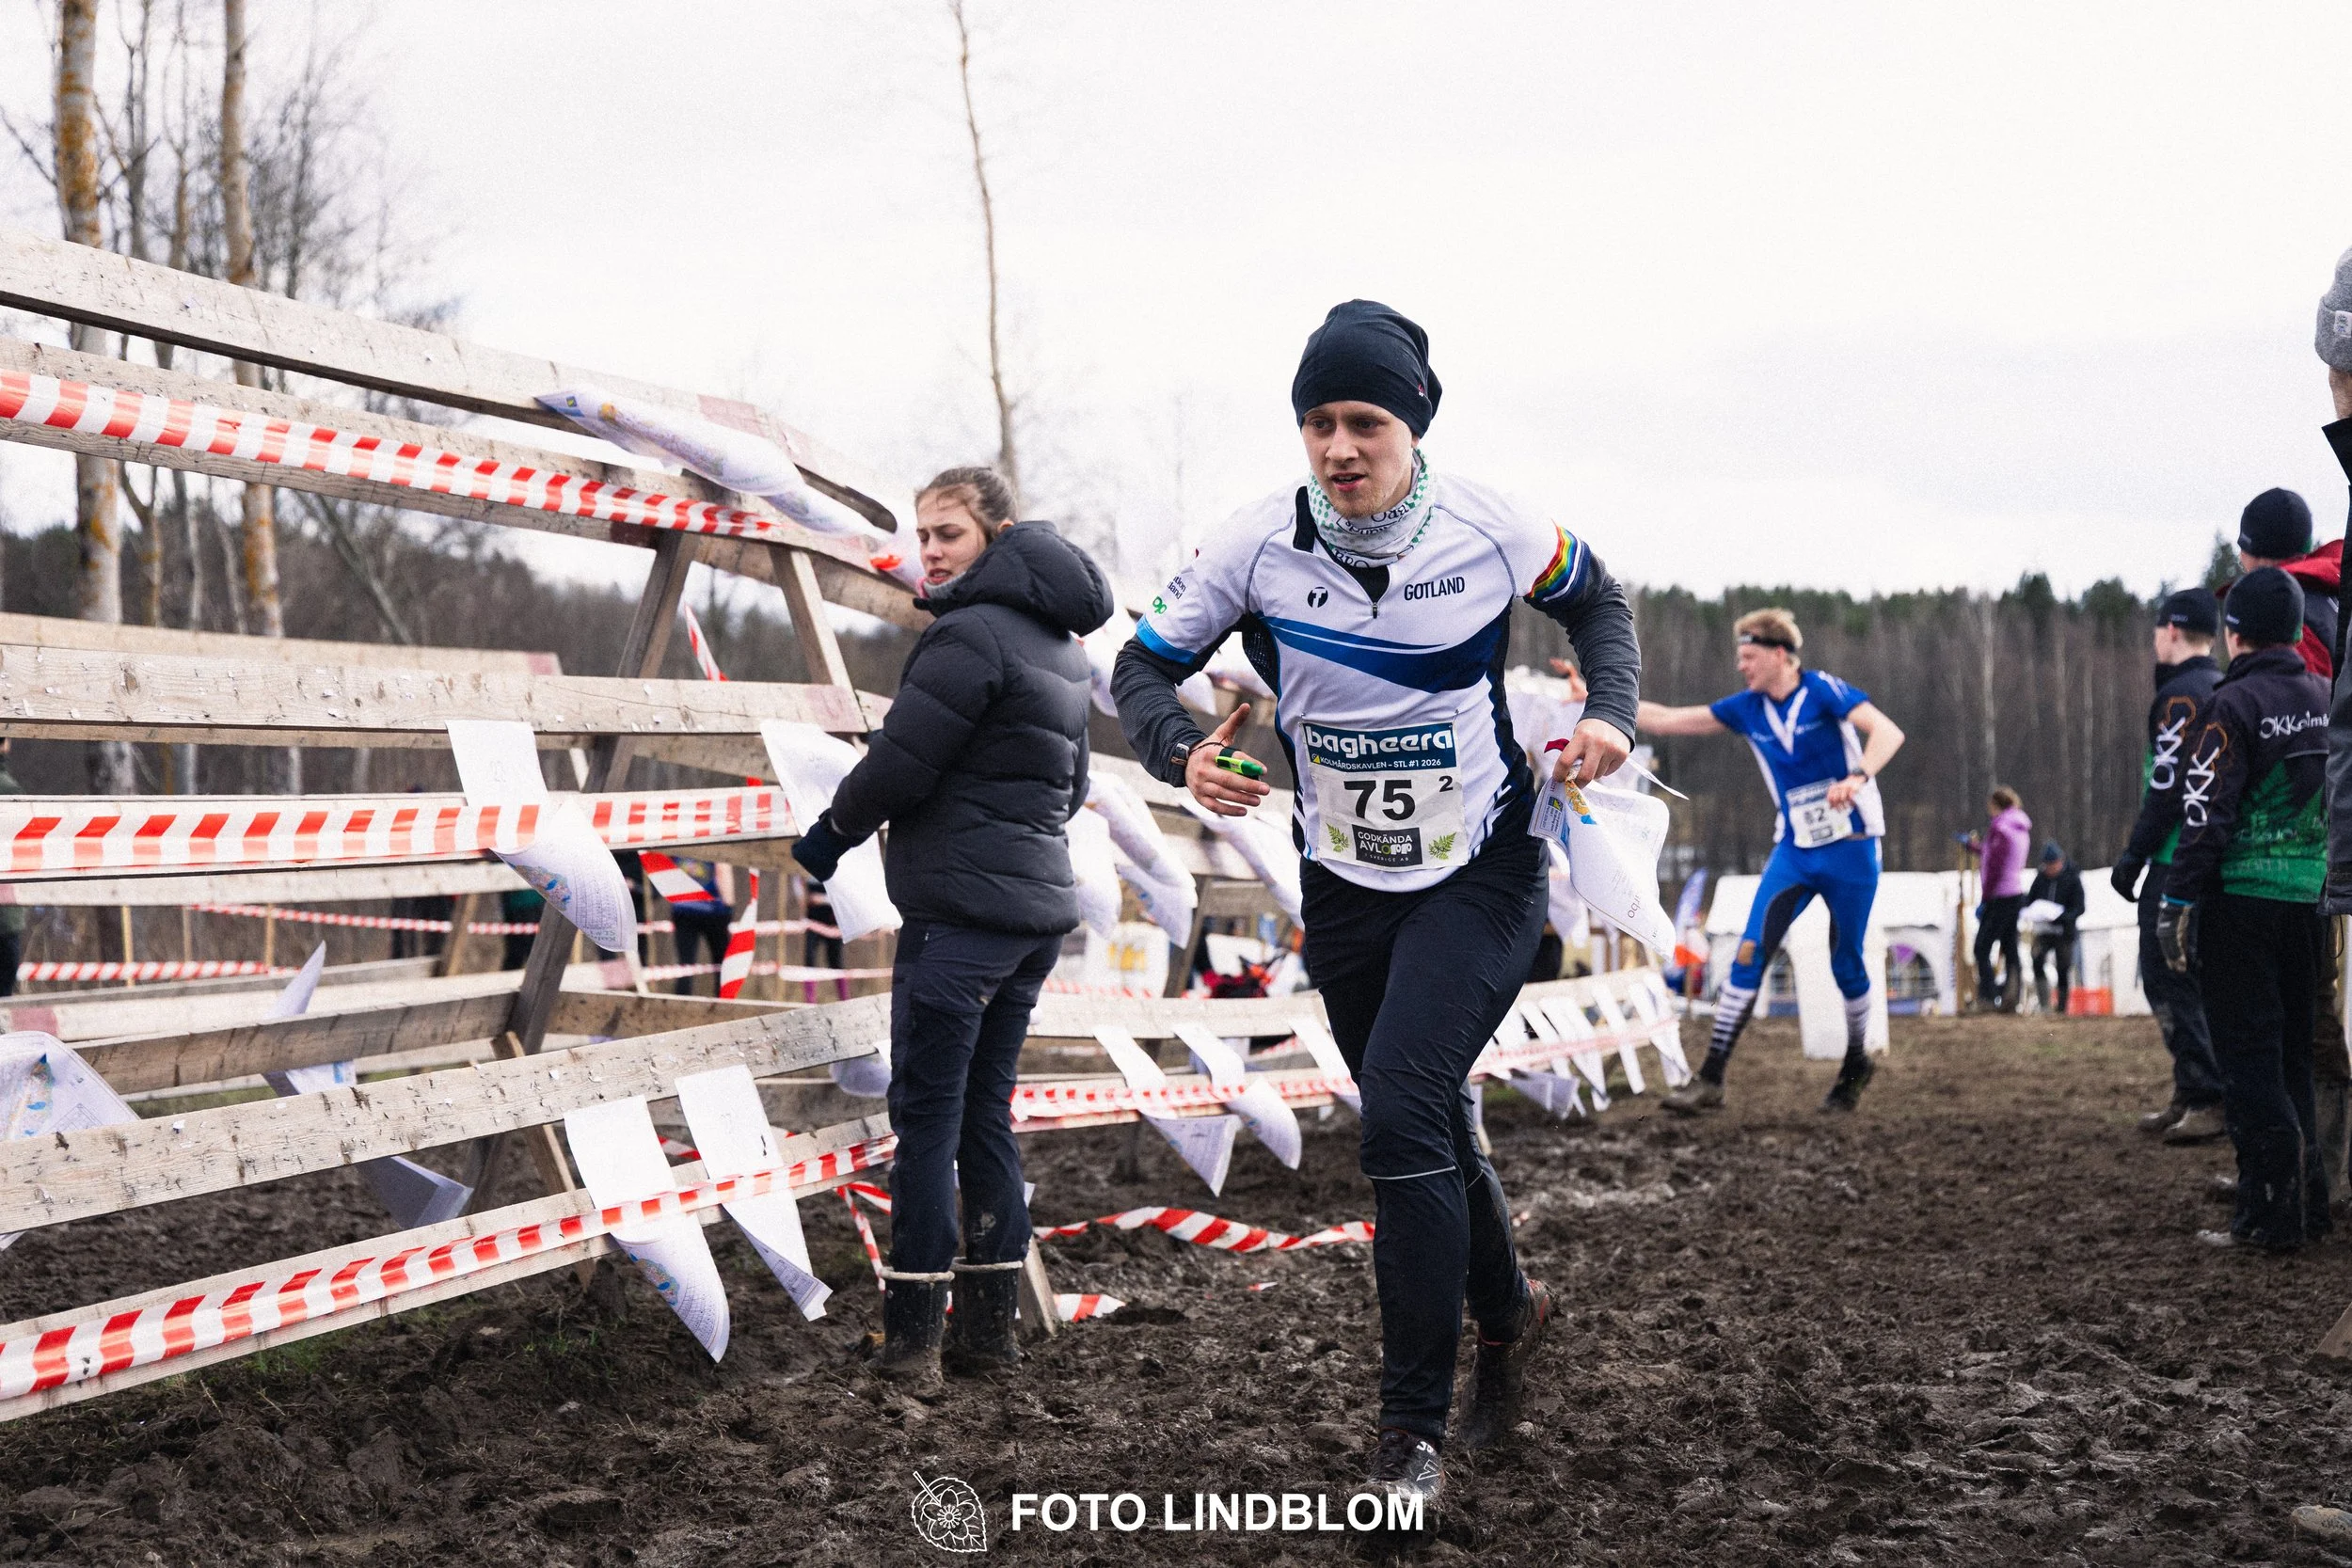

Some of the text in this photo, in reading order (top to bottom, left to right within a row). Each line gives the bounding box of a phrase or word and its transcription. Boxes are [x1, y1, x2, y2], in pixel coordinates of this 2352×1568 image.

[1404, 577, 1466, 601] GOTLAND
[1305, 726, 1454, 759] bagheera
[1320, 756, 1387, 770] KOLMÅRDSKAVLEN
[1393, 760, 1407, 768] STL
[1408, 759, 1419, 768] #1
[1421, 758, 1441, 768] 2026
[1438, 775, 1454, 793] 2
[1343, 779, 1416, 821] 75
[1358, 832, 1413, 844] GODKÄNDA
